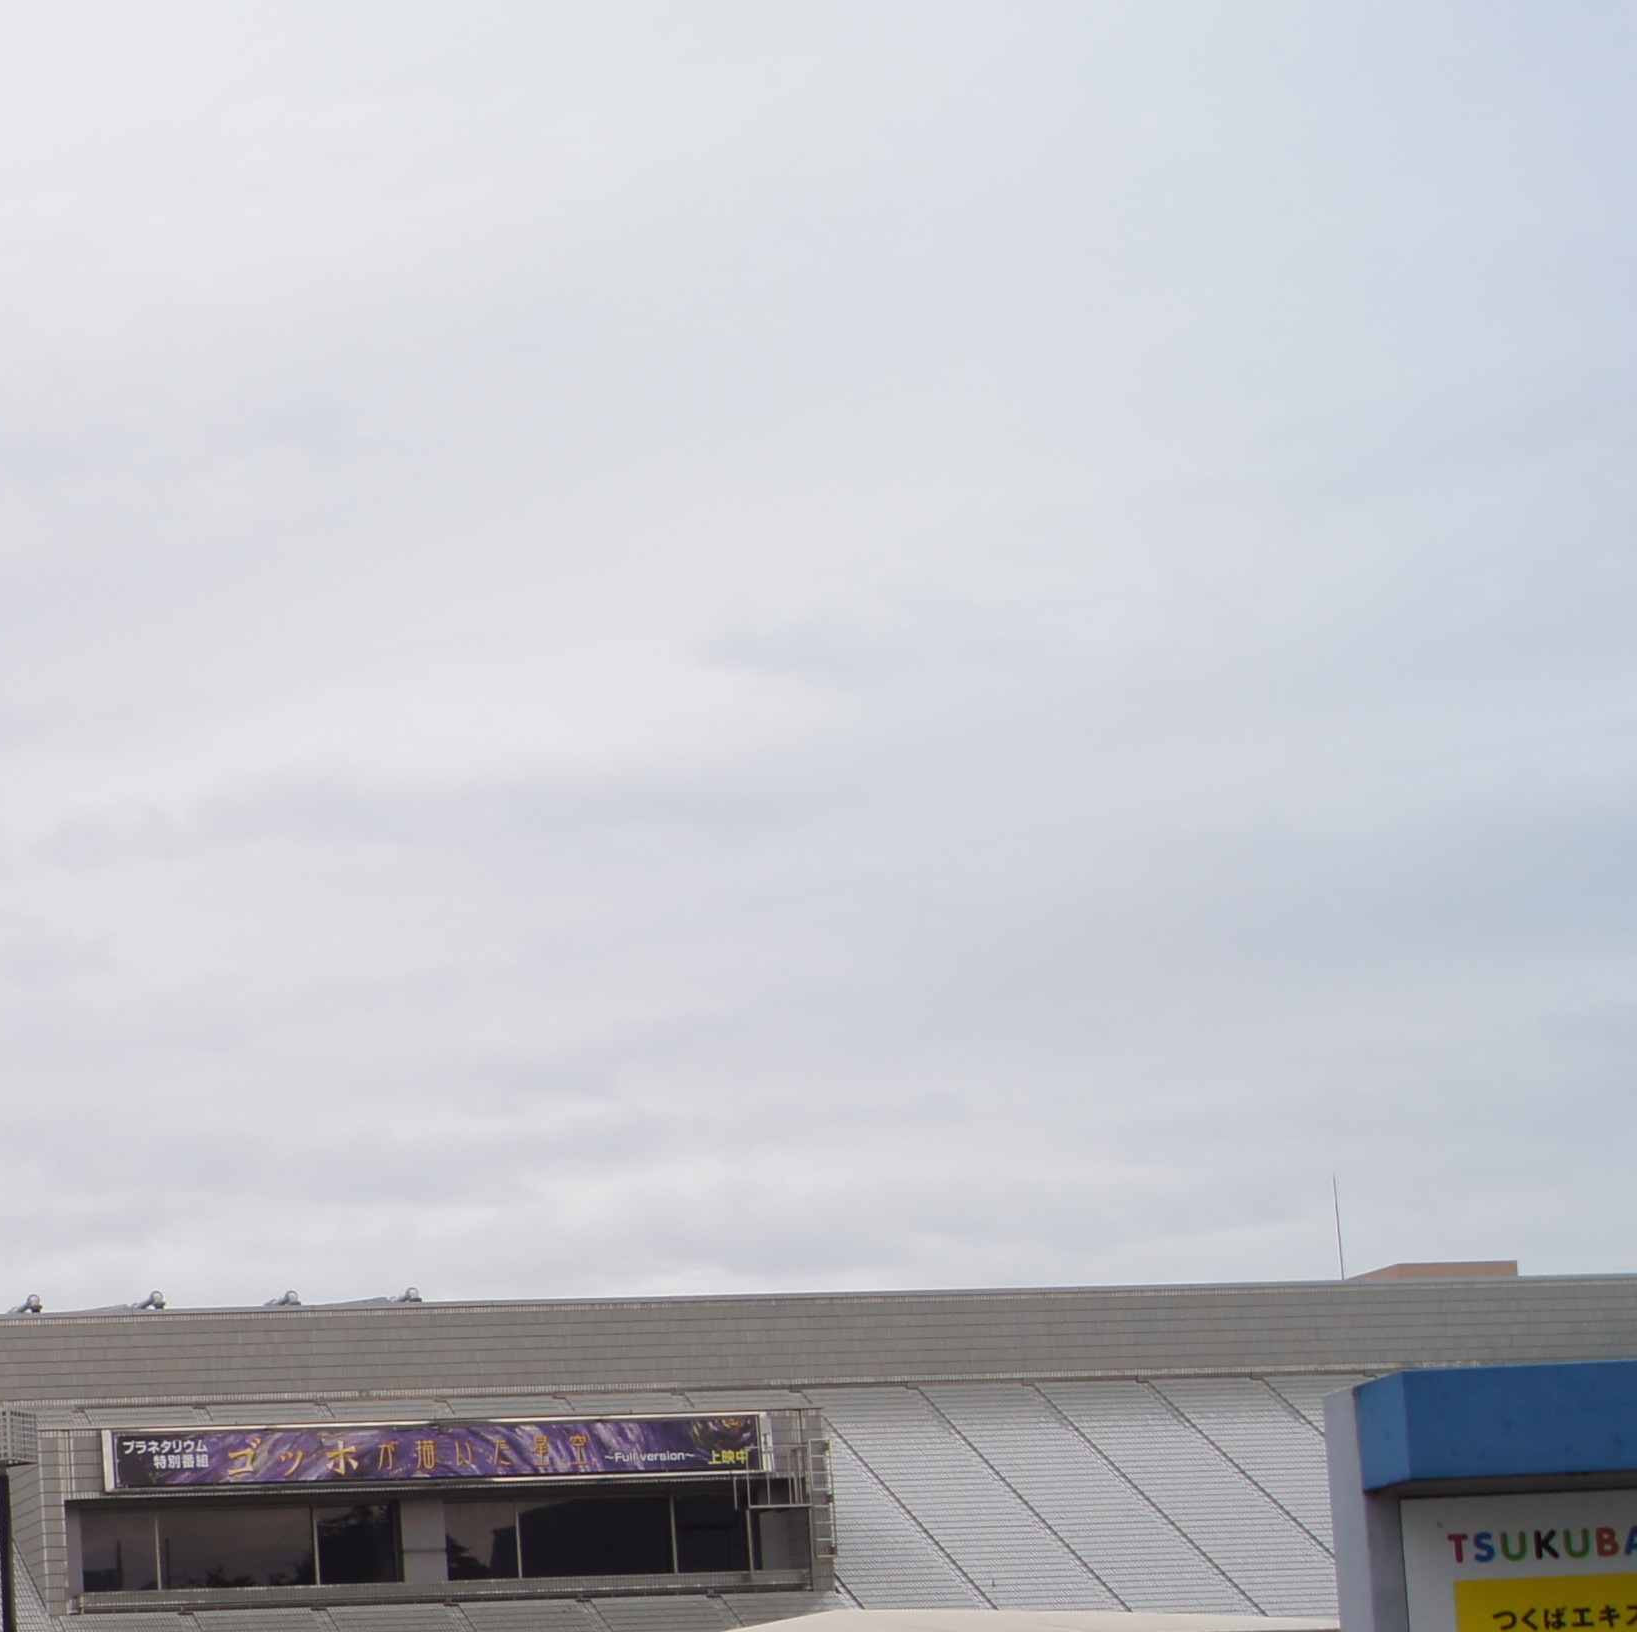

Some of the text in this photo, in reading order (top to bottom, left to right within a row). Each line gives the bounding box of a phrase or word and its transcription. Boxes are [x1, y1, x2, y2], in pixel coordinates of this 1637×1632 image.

[122, 1440, 208, 1455] プラネタリウム
[153, 1453, 209, 1469] 特別番組
[708, 1449, 749, 1465] 上映中
